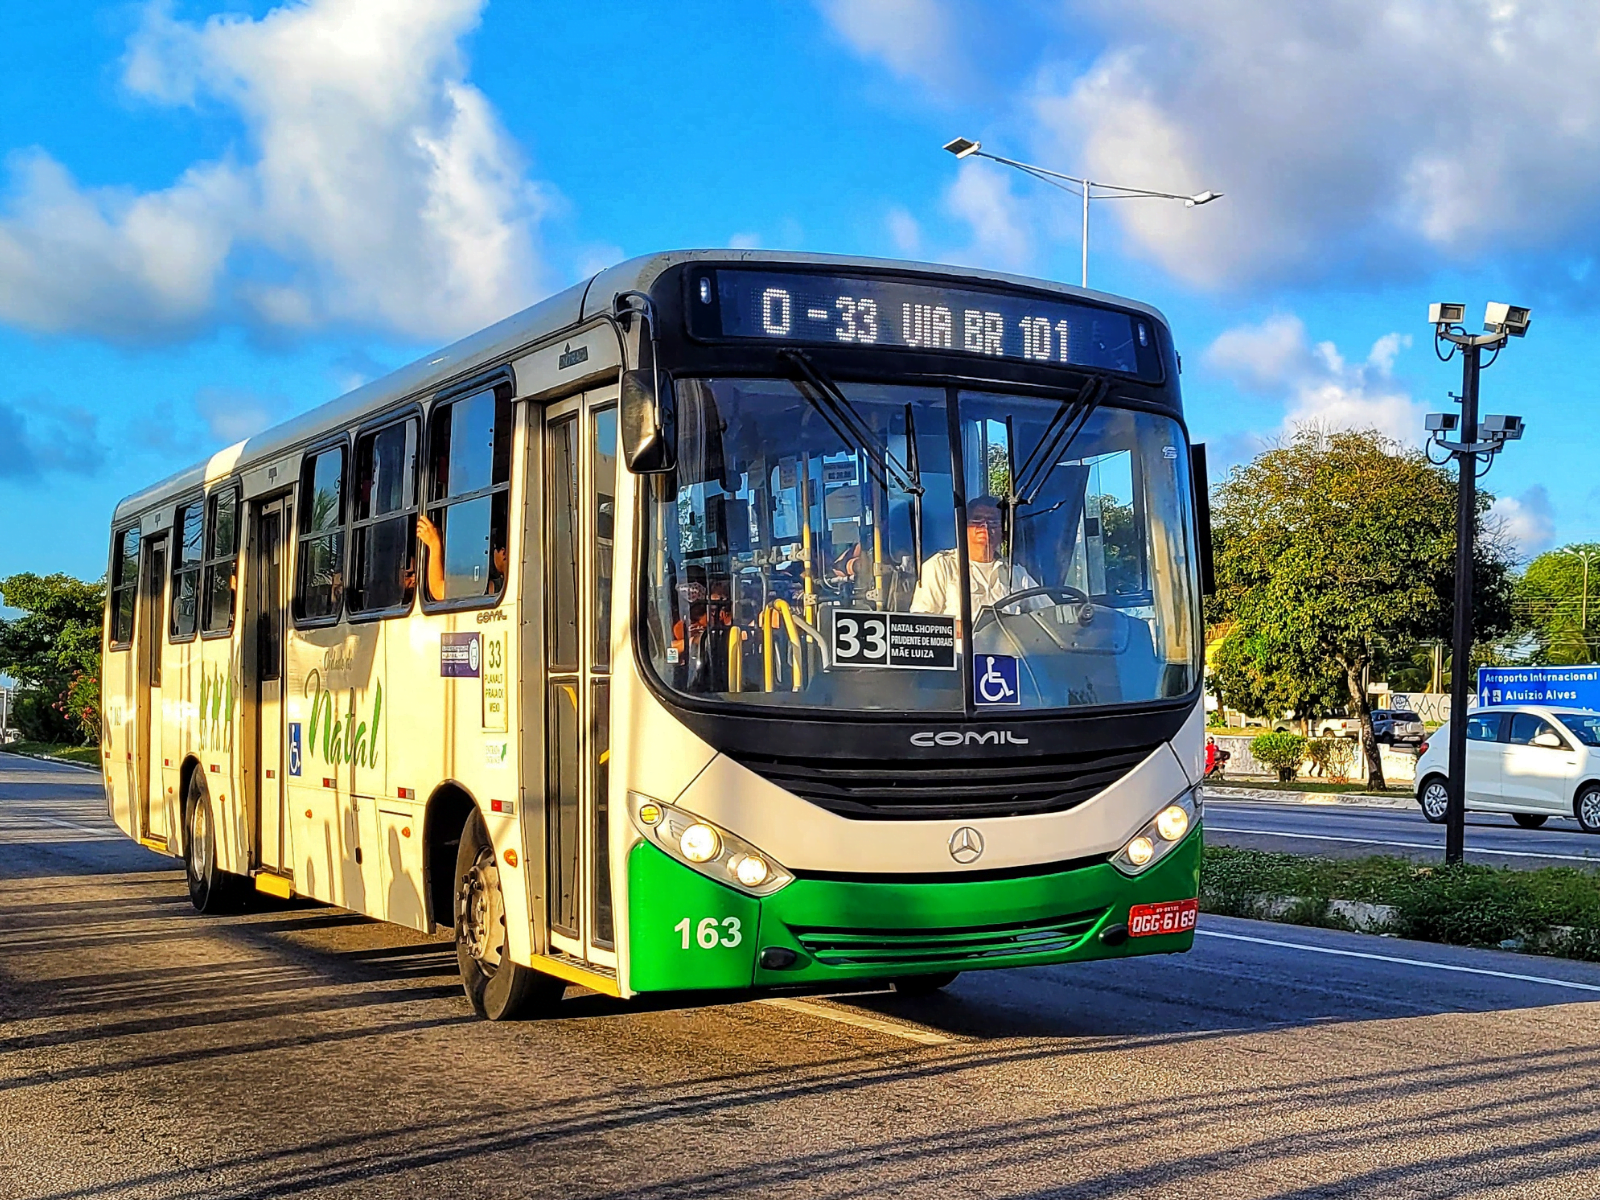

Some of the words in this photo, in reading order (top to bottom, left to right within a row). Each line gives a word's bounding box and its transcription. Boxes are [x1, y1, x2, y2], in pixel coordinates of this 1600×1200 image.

[902, 302, 952, 347] VIA
[963, 308, 1004, 356] BR
[1018, 315, 1069, 362] 101
[891, 623, 914, 633] NATAL
[915, 624, 953, 635] SHOPPING
[836, 618, 887, 659] 33
[891, 635, 921, 646] PRUDENTE
[921, 637, 930, 646] DE
[930, 637, 953, 647] MORAIS
[488, 640, 502, 669] 33
[891, 646, 910, 658] MÃE
[910, 649, 935, 659] LUIZA
[1485, 673, 1528, 684] Aeroporto
[1530, 671, 1598, 682] Internacional
[1545, 690, 1577, 700] Alves
[304, 668, 382, 770] Natal
[910, 730, 1029, 747] COMIL
[674, 916, 742, 950] 163
